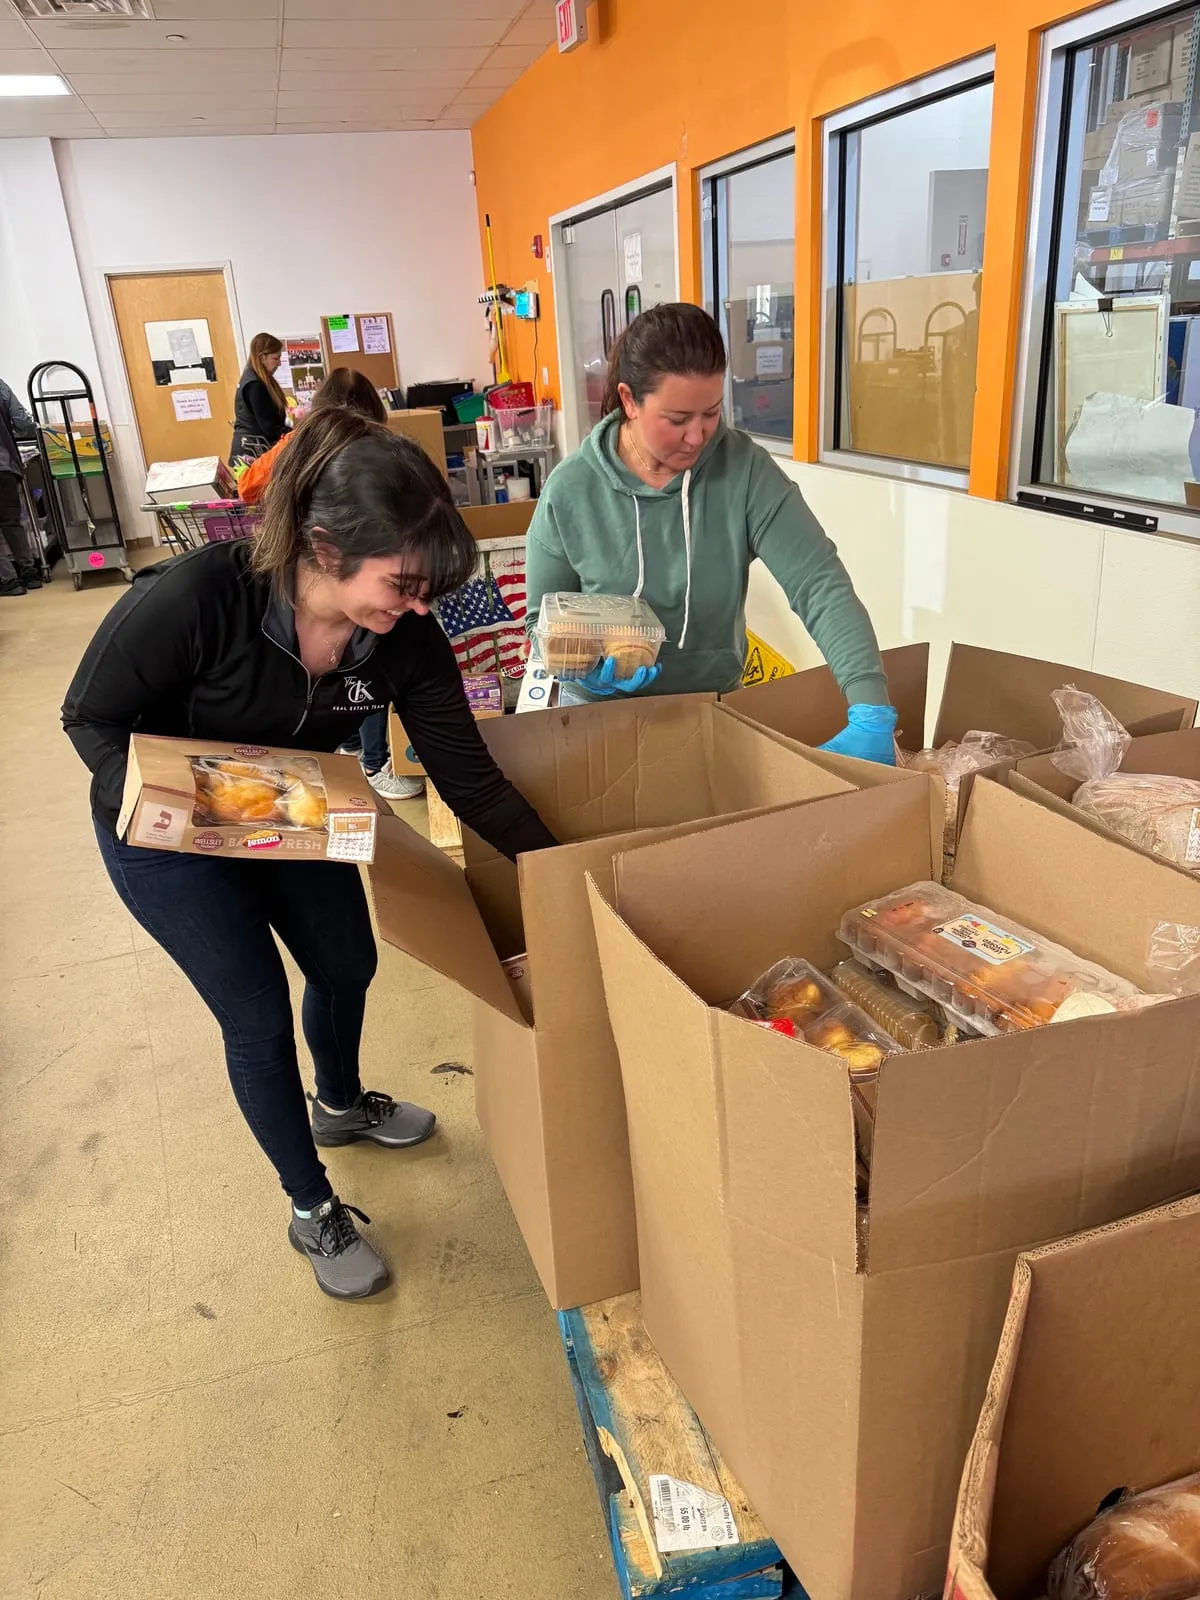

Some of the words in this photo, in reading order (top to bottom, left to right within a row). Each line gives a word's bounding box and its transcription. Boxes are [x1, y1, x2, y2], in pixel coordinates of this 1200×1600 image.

[558, 0, 573, 43] EXIT
[193, 838, 223, 847] WELLSLEY
[247, 835, 280, 848] lemon
[282, 838, 322, 851] FRESH
[981, 938, 1012, 955] FLAVORED
[981, 942, 1003, 955] LEMON
[725, 1521, 734, 1539] Foods
